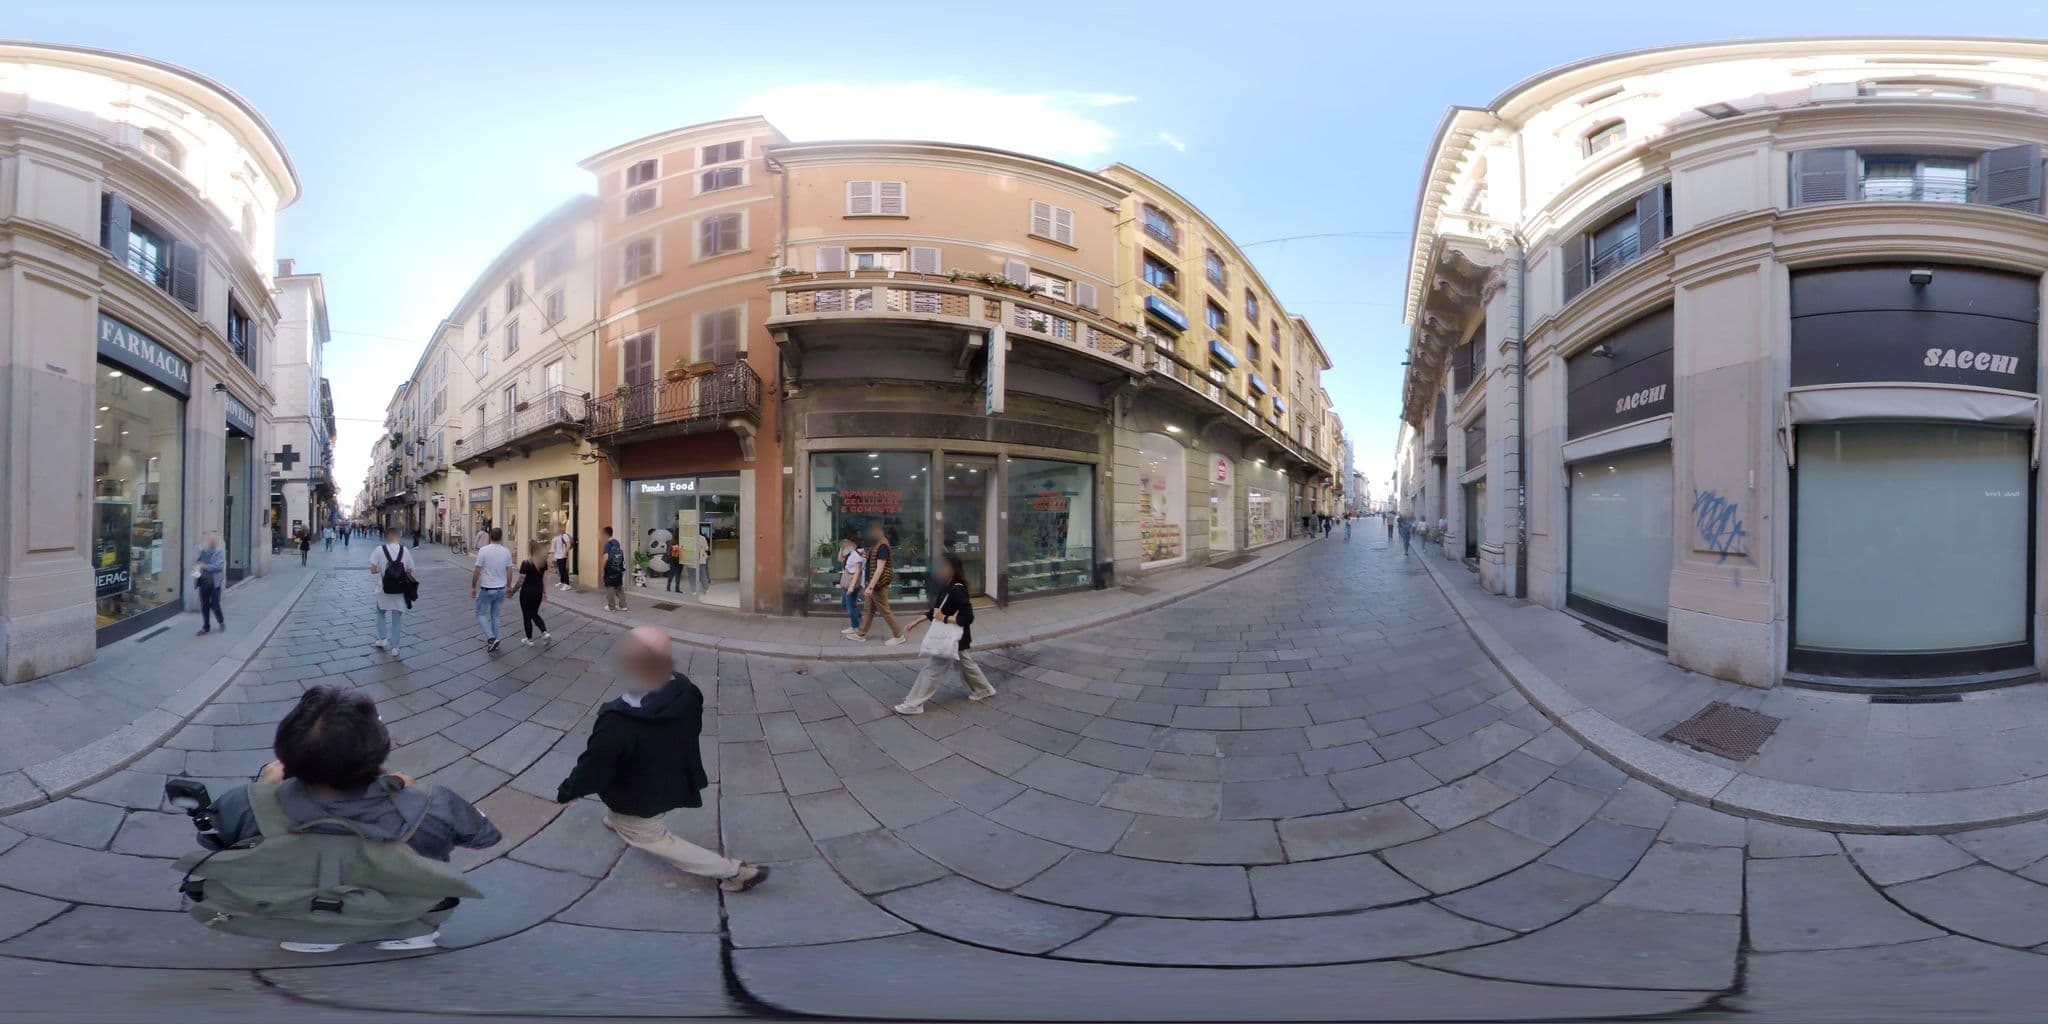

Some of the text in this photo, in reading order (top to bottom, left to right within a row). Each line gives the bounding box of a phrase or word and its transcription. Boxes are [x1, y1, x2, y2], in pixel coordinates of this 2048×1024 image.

[101, 320, 188, 383] FARMACIA
[1923, 348, 2019, 375] SACCHI
[1615, 383, 1667, 414] SACCHI
[641, 481, 695, 493] Panda Food
[96, 571, 128, 587] IERAC
